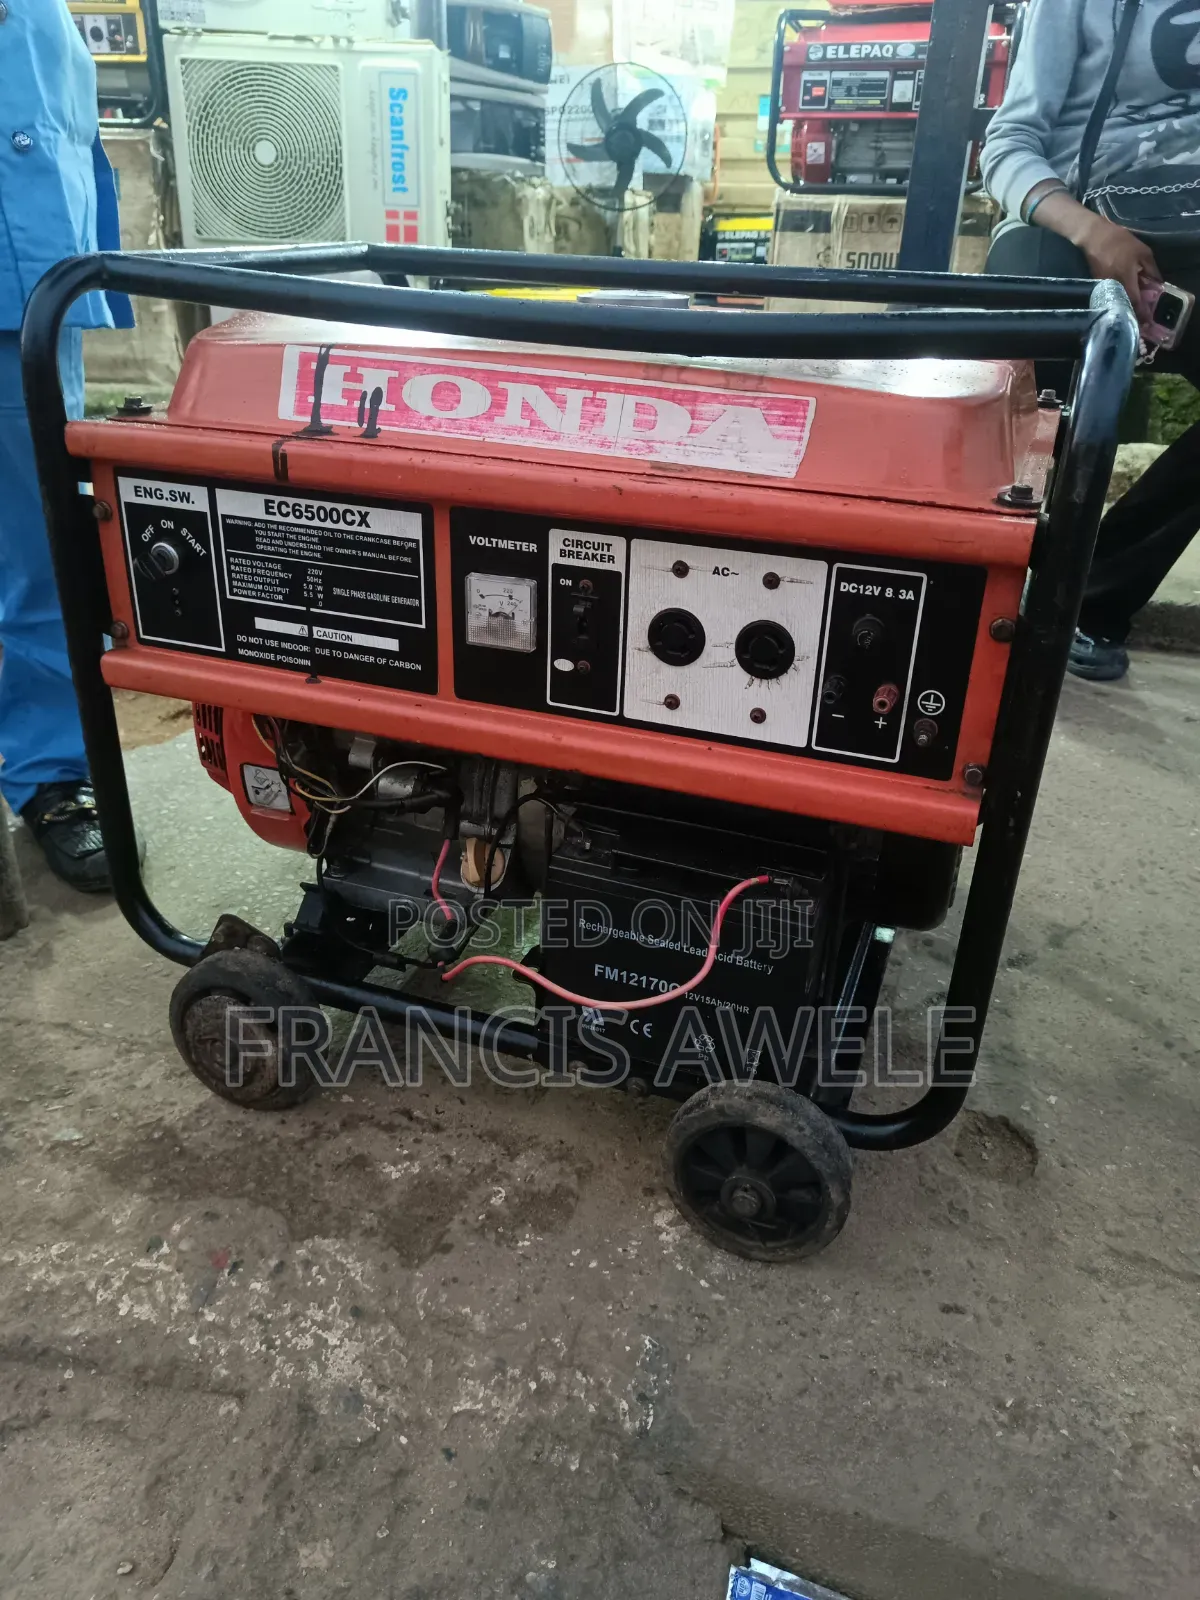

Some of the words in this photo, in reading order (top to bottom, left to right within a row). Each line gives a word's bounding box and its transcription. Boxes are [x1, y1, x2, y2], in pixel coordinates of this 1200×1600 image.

[826, 44, 894, 59] ELEPAQ
[388, 87, 410, 192] Scanfrost
[309, 361, 786, 453] HONDA
[133, 485, 195, 504] ENG.SW.
[264, 499, 371, 529] EC6500CX
[161, 519, 174, 529] ON
[141, 524, 155, 542] OFF
[279, 525, 322, 535] RECOMMENDED
[356, 535, 391, 545] CRANKCASE
[393, 540, 416, 548] BEFORE
[180, 528, 207, 557] START
[256, 544, 287, 553] OPERATING
[469, 535, 537, 552] VOLTMETER
[562, 538, 612, 552] CIRCUIT
[284, 540, 321, 550] UNDERSTAND
[363, 551, 387, 559] MANUAL
[388, 555, 412, 563] BEFORE
[560, 549, 615, 564] BREAKER
[230, 557, 251, 565] RATED
[252, 560, 281, 570] VOLTAGE
[231, 565, 251, 573] RATED
[253, 568, 292, 579] FREQUENCY
[232, 580, 262, 590] MAXIMUM
[264, 585, 289, 594] OUTPUT
[254, 576, 279, 585] OUTPUT
[560, 578, 572, 586] ON
[840, 582, 882, 596] DC12V
[233, 588, 256, 596] POWER
[258, 591, 283, 600] FACTOR
[333, 587, 350, 596] SINGLE
[351, 590, 366, 599] PHASE
[367, 592, 390, 602] GASOLINE
[391, 596, 420, 607] GENERATOR
[316, 630, 353, 642] CAUTION
[238, 648, 275, 660] MONOXIDE
[277, 655, 311, 666] POISONIN
[315, 647, 330, 656] DUE
[332, 650, 342, 658] TO
[344, 652, 375, 663] DANGER
[389, 659, 422, 671] CARBON
[579, 918, 645, 942] Rechargeable
[648, 934, 680, 951] Sealed
[684, 943, 707, 957] Lead
[736, 955, 774, 974] Battery
[630, 1020, 652, 1038] CE
